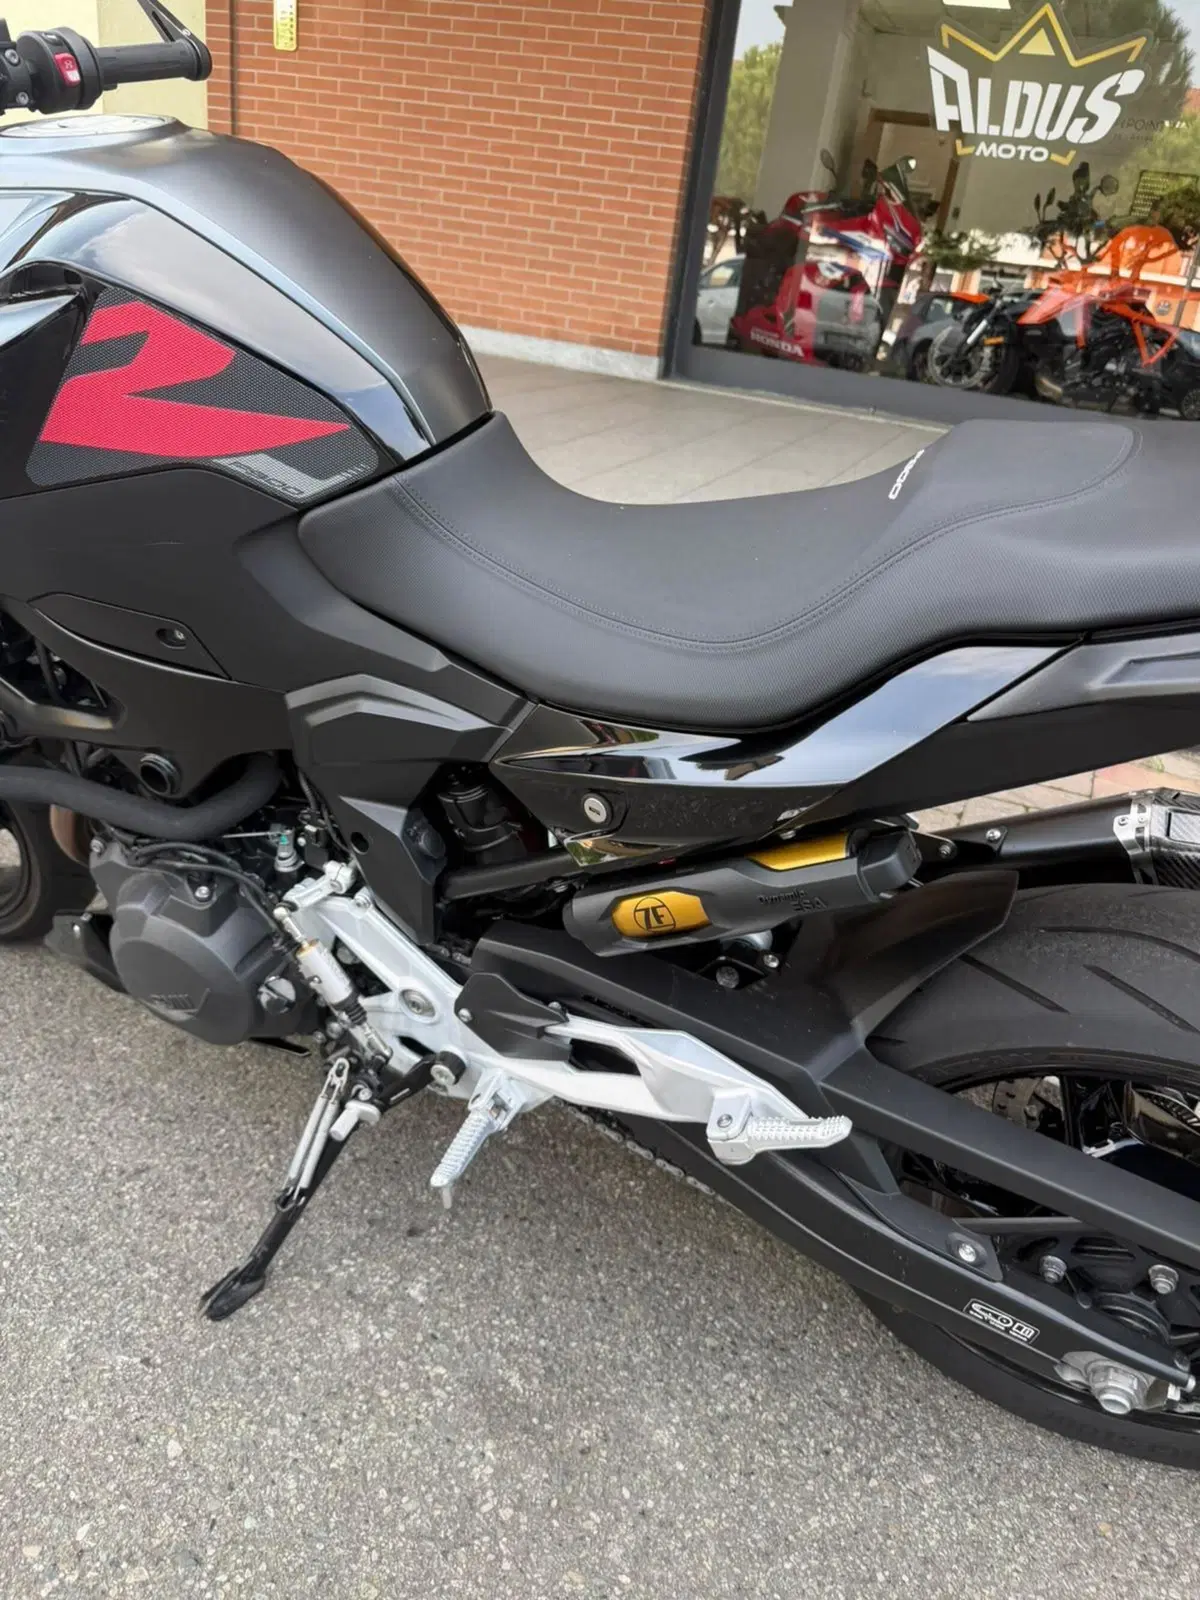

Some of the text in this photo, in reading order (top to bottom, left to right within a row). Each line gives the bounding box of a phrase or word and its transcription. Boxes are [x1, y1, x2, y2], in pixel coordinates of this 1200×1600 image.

[927, 46, 1146, 144] ALDUS
[975, 141, 1049, 162] MOTO
[750, 331, 805, 358] HONDA
[634, 904, 676, 931] ZF
